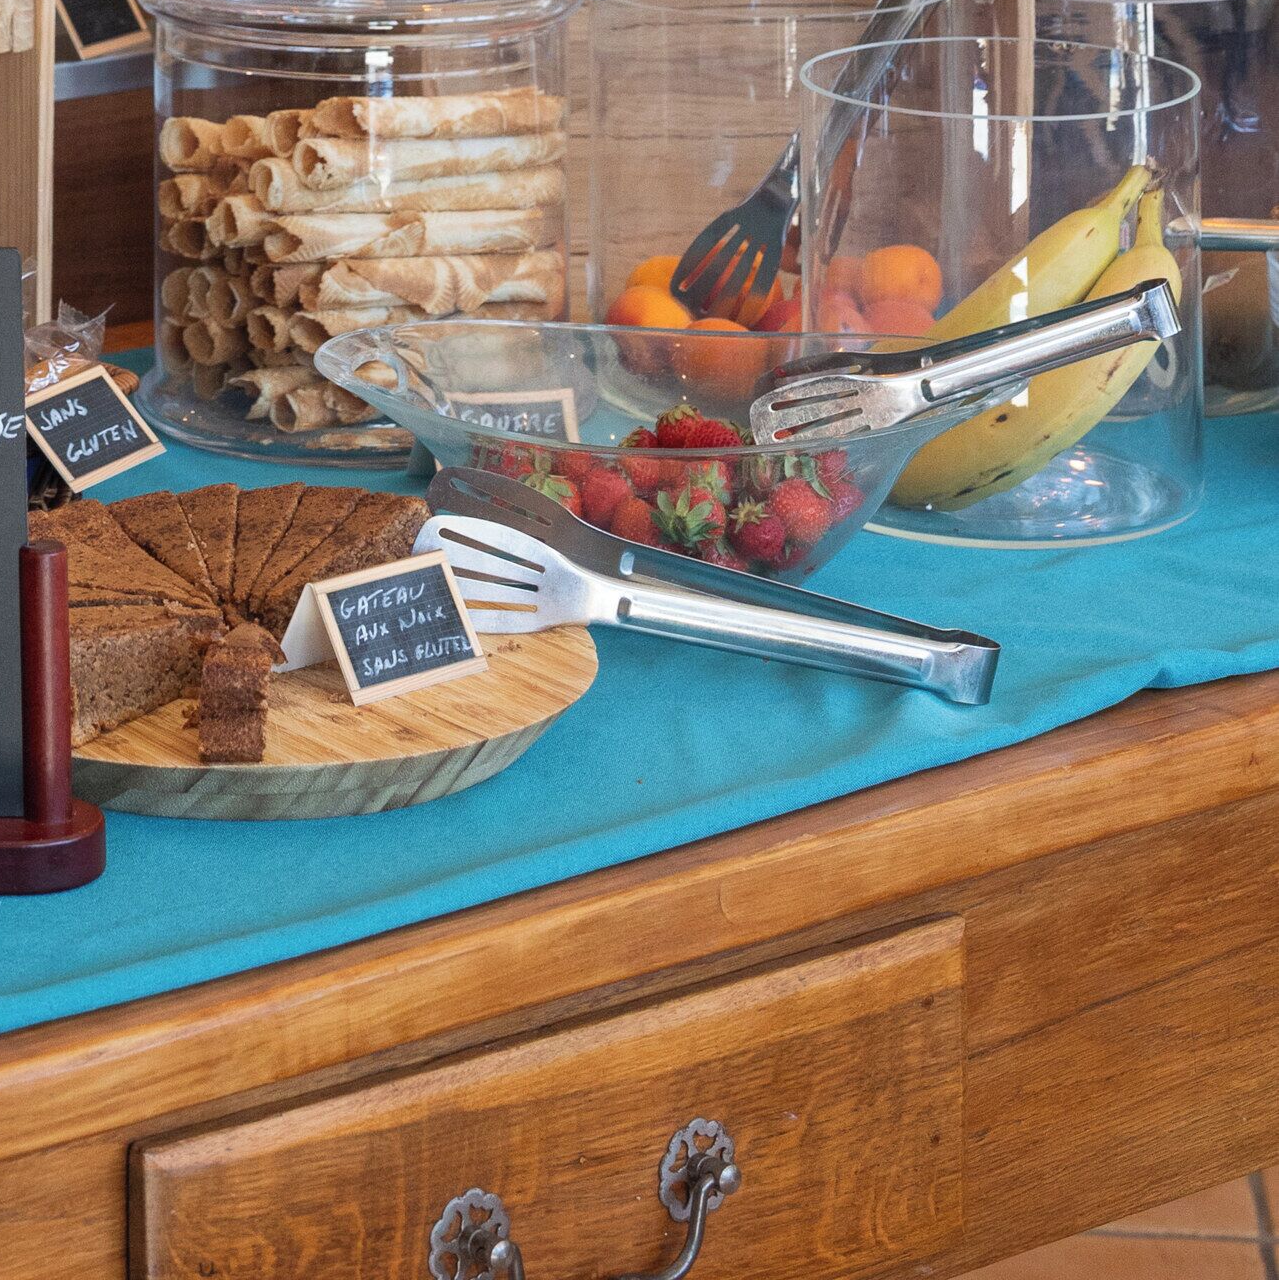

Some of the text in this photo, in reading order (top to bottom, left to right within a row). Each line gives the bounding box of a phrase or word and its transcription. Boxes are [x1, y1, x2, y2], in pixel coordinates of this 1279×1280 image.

[40, 398, 88, 431] SANS
[66, 418, 139, 463] GLUTEN
[340, 582, 425, 619] GATEAU
[363, 648, 409, 677] SANS
